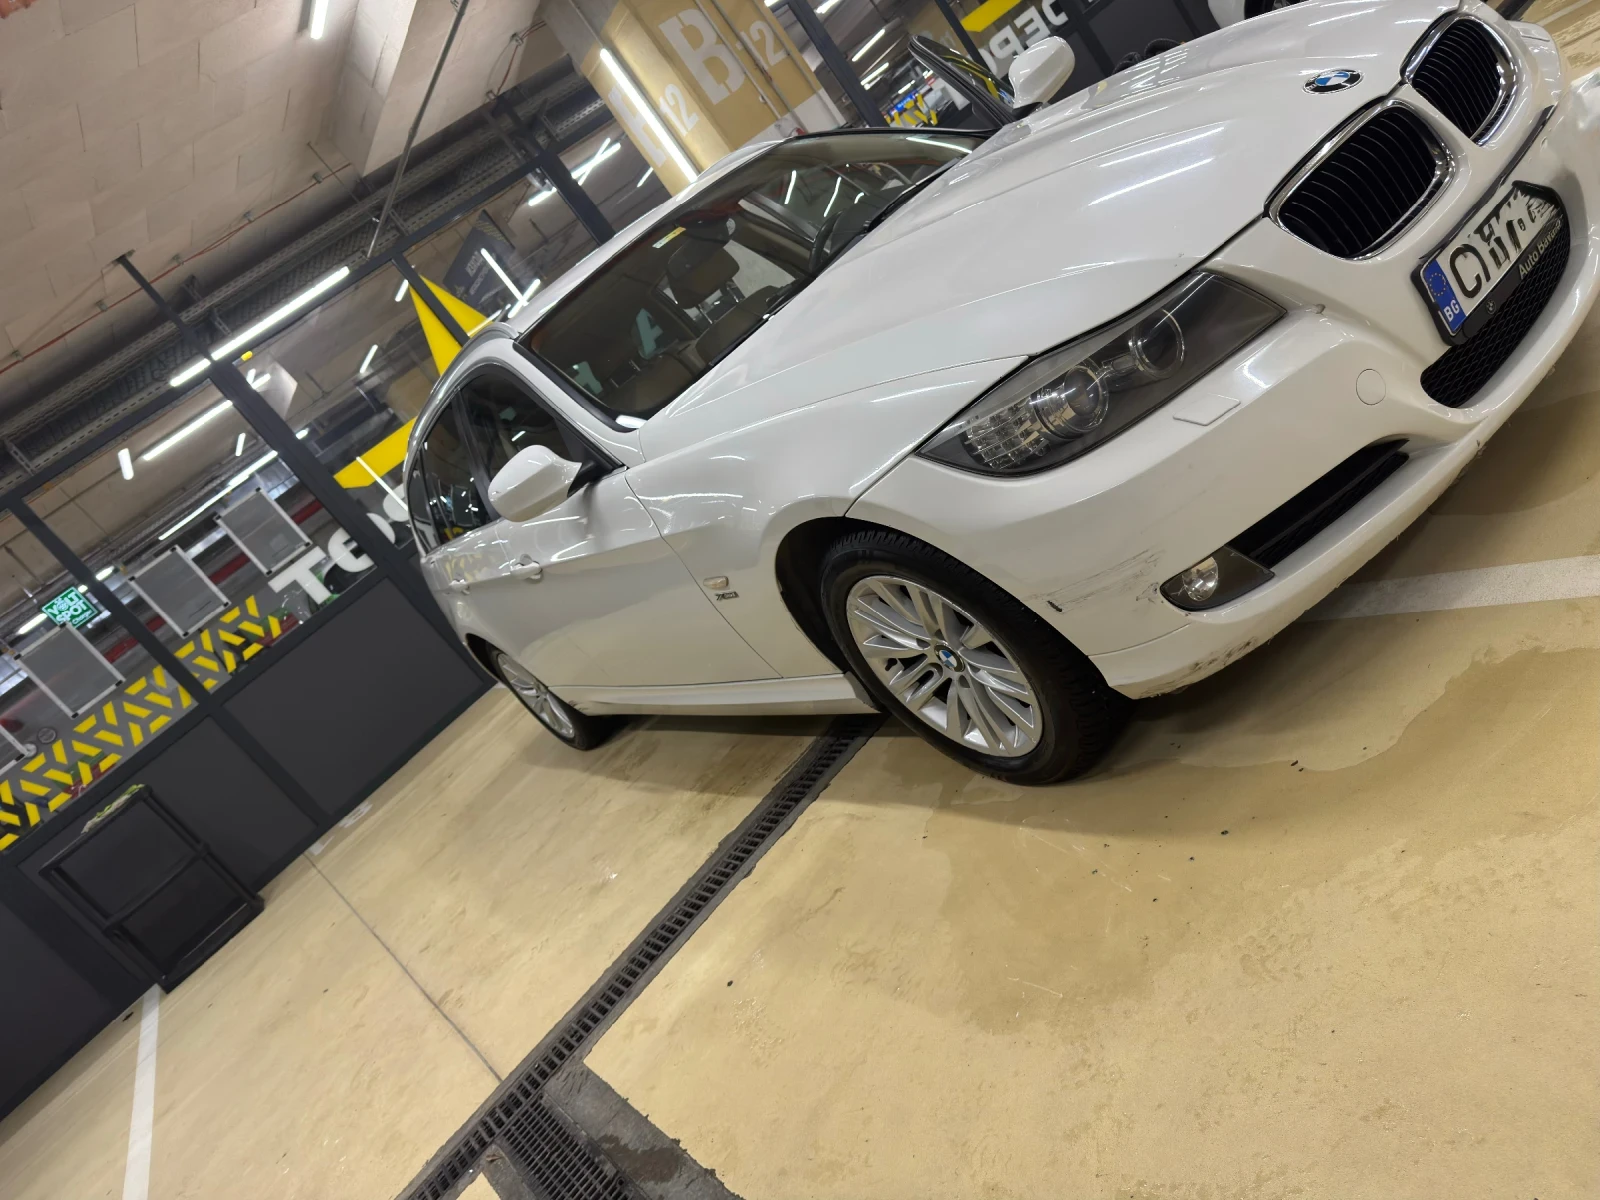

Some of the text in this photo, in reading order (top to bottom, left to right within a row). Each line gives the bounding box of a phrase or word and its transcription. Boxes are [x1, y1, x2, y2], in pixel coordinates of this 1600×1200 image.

[658, 8, 789, 105] B 12
[659, 83, 698, 137] 12
[1518, 251, 1539, 280] Auto
[1443, 299, 1460, 322] BG
[56, 600, 88, 622] SPOT
